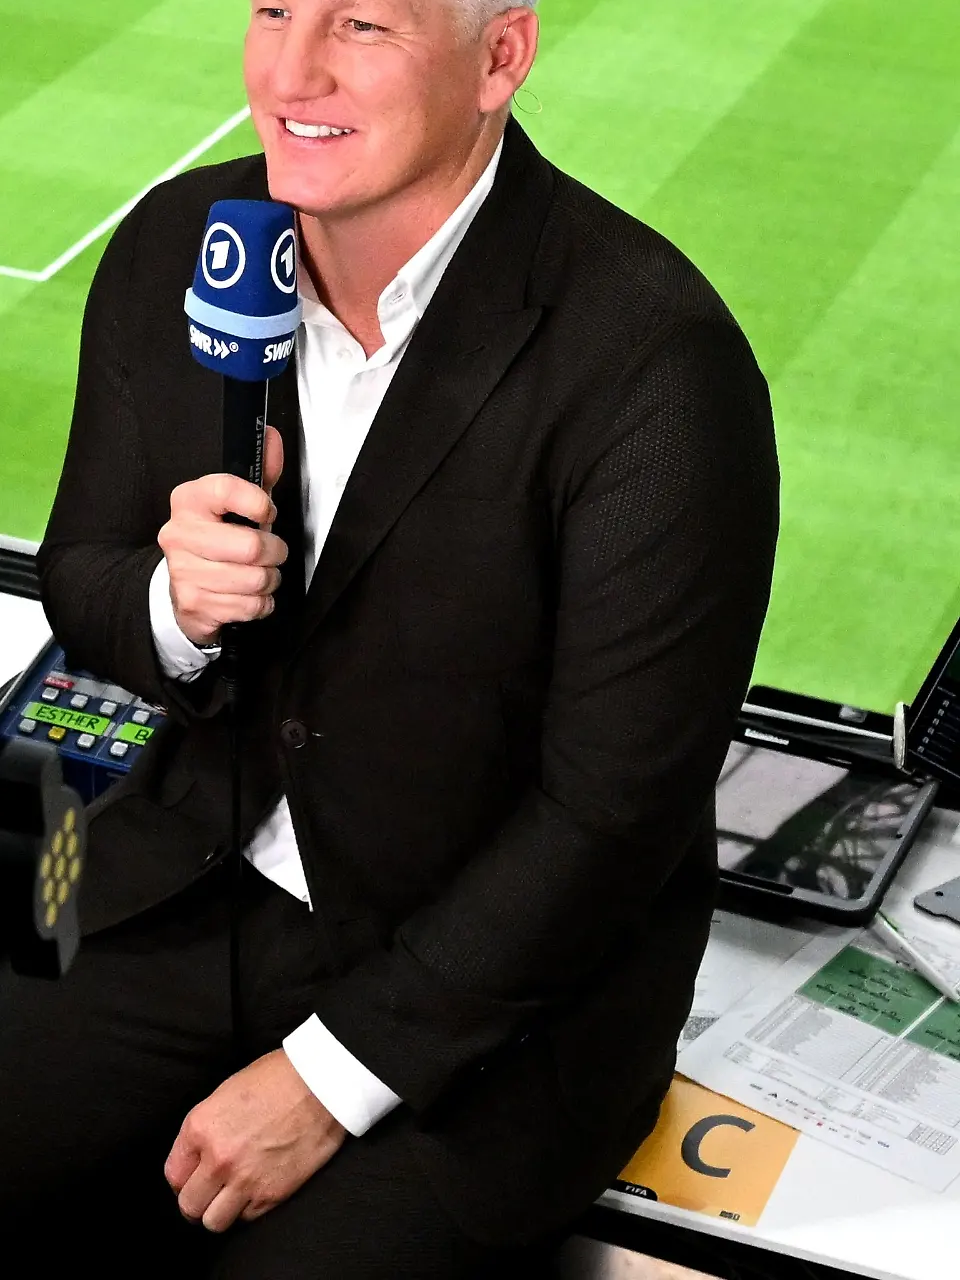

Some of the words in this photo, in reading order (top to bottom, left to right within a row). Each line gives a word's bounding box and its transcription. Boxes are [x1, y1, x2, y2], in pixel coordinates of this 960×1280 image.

[190, 324, 213, 356] SWR
[262, 337, 292, 365] SWR
[36, 706, 100, 730] ESTHER
[681, 1114, 756, 1178] C
[625, 1185, 647, 1196] FIFA
